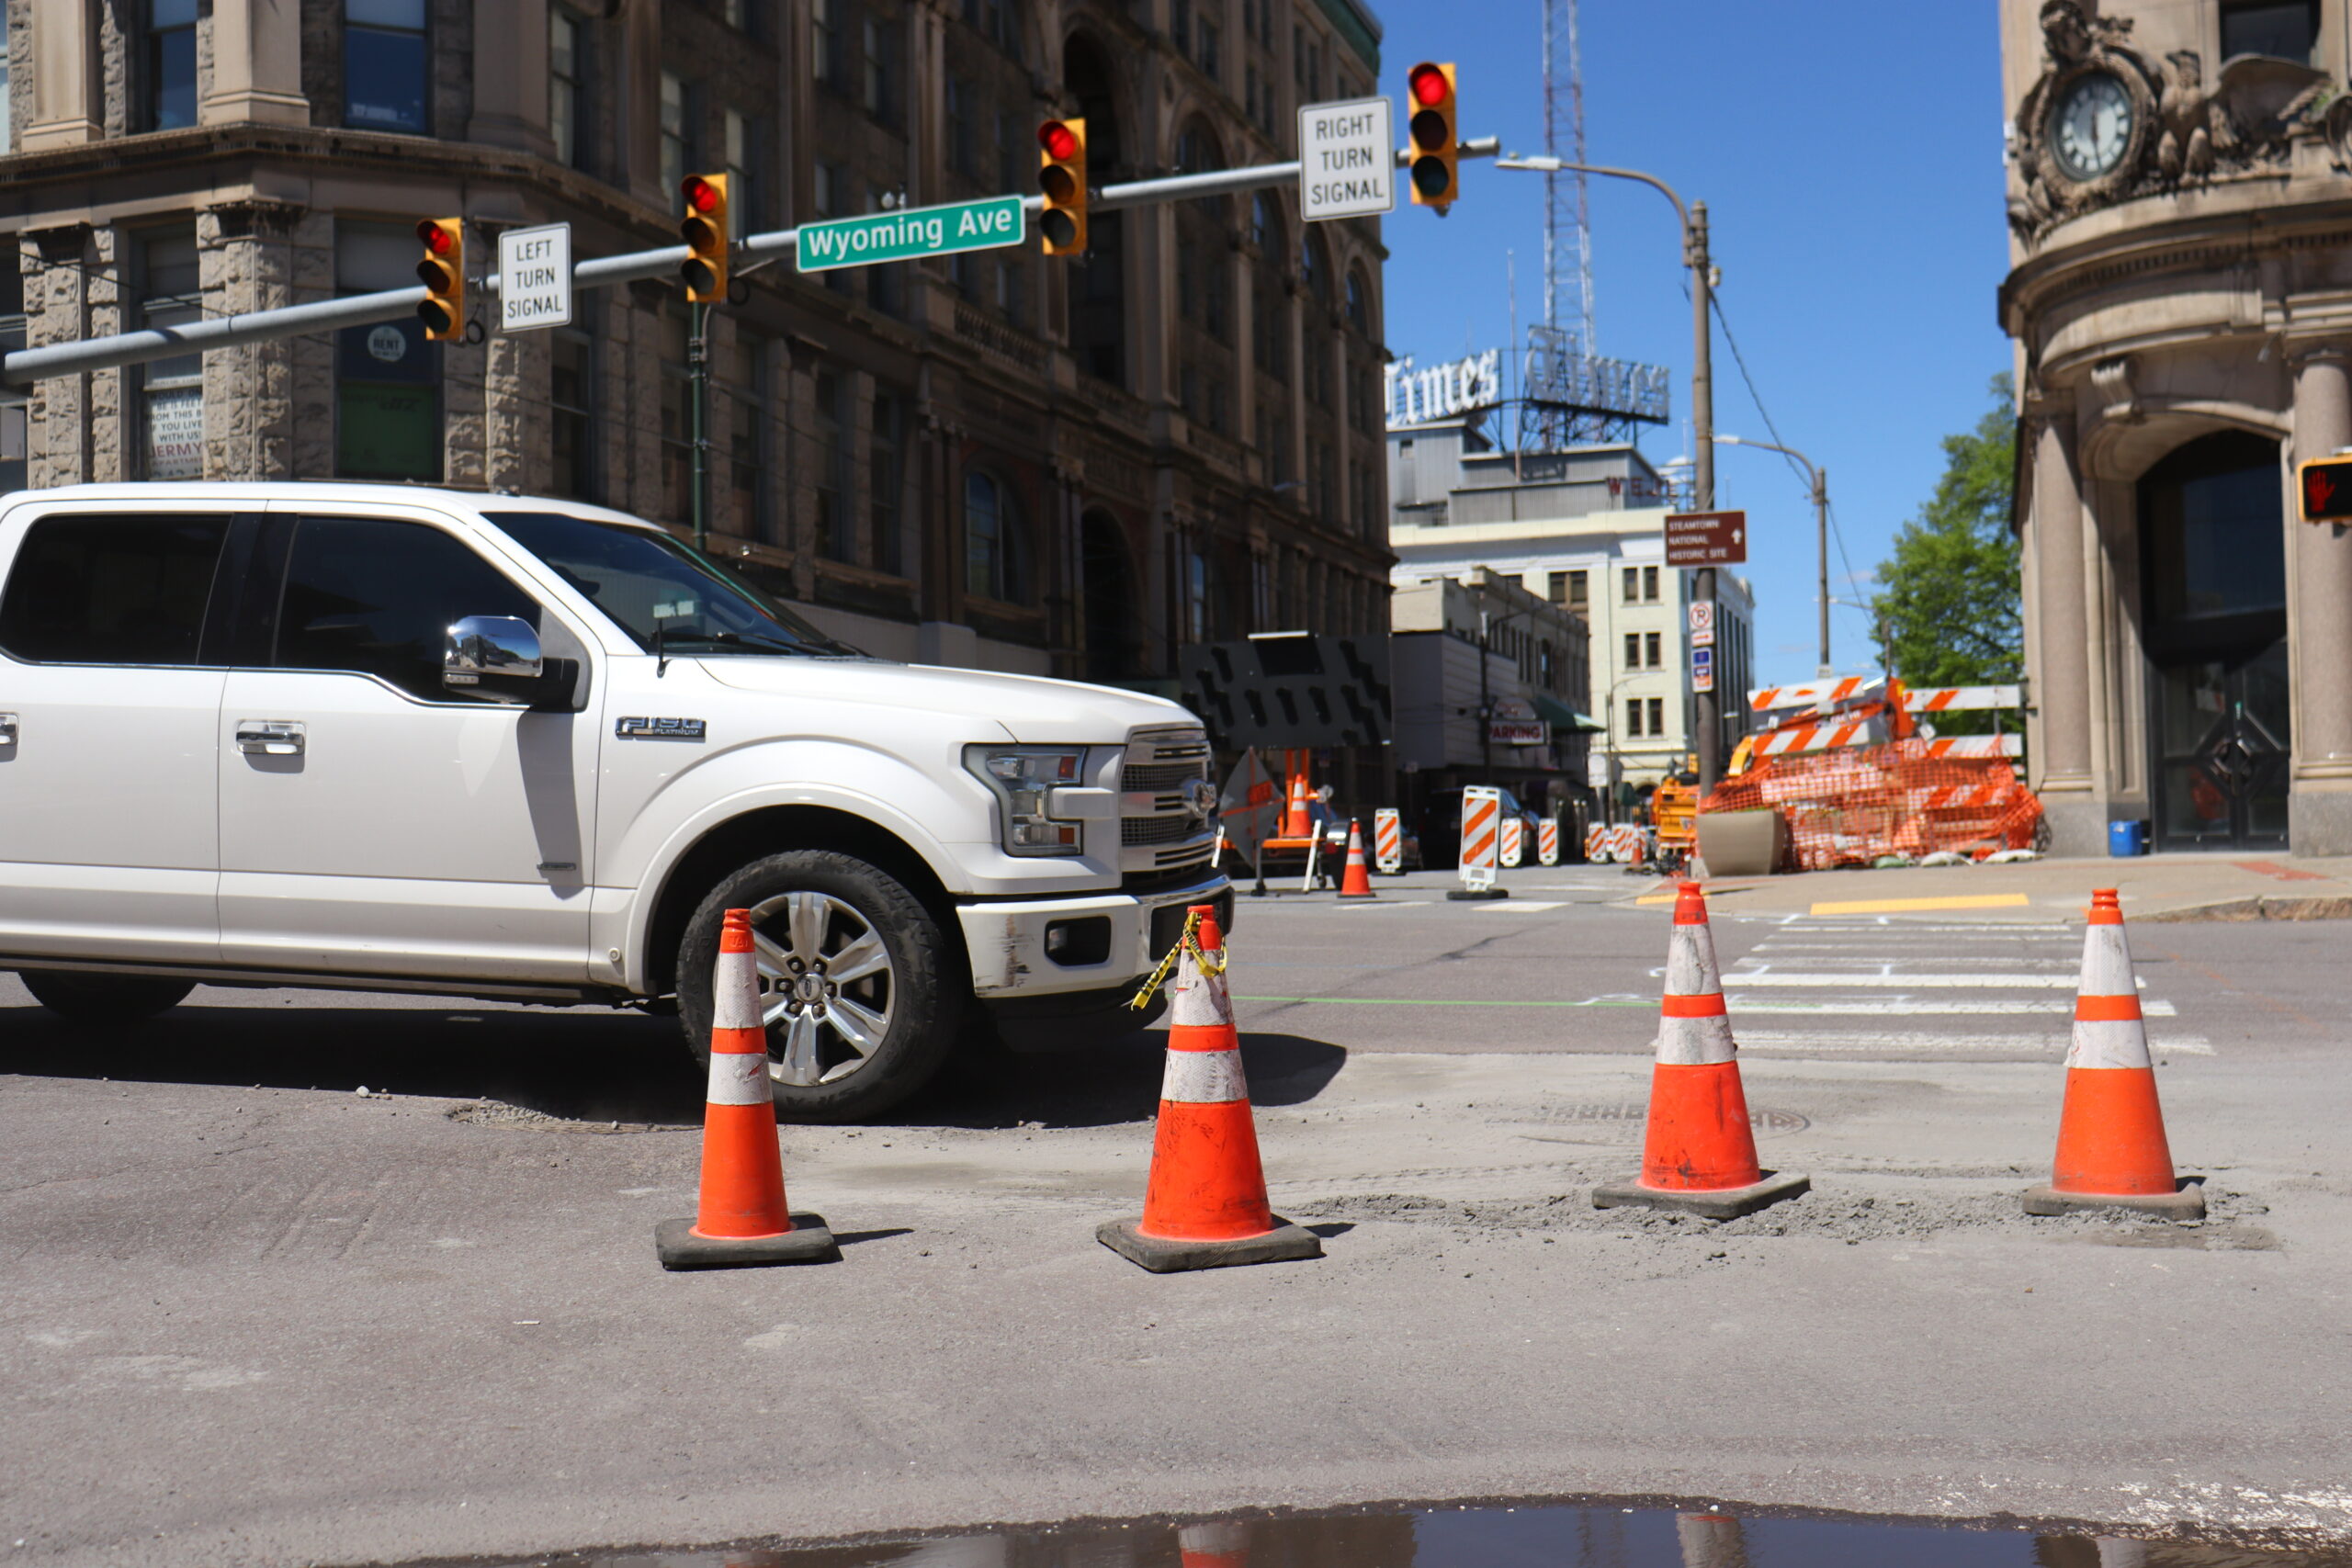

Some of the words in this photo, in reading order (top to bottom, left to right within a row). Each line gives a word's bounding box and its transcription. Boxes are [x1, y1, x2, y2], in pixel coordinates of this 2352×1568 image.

[1316, 114, 1374, 141] RIGHT
[1321, 147, 1373, 172] TURN
[1312, 178, 1385, 205] SIGNAL
[808, 217, 943, 261] Wyoming
[958, 209, 1012, 237] Ave
[516, 240, 552, 262] LEFT
[515, 267, 555, 289] TURN
[507, 295, 562, 319] SIGNAL
[1524, 328, 1669, 413] Times
[174, 411, 192, 419] THIS
[161, 423, 180, 432] YOU
[159, 433, 184, 442] WITH
[1668, 518, 1720, 532] STEAMTOWN
[1668, 535, 1709, 546] NATIONAL
[1668, 548, 1706, 561] HISTORIC
[1709, 547, 1728, 558] SITE
[653, 728, 698, 736] PLATINUM
[1489, 725, 1541, 739] ARKING
